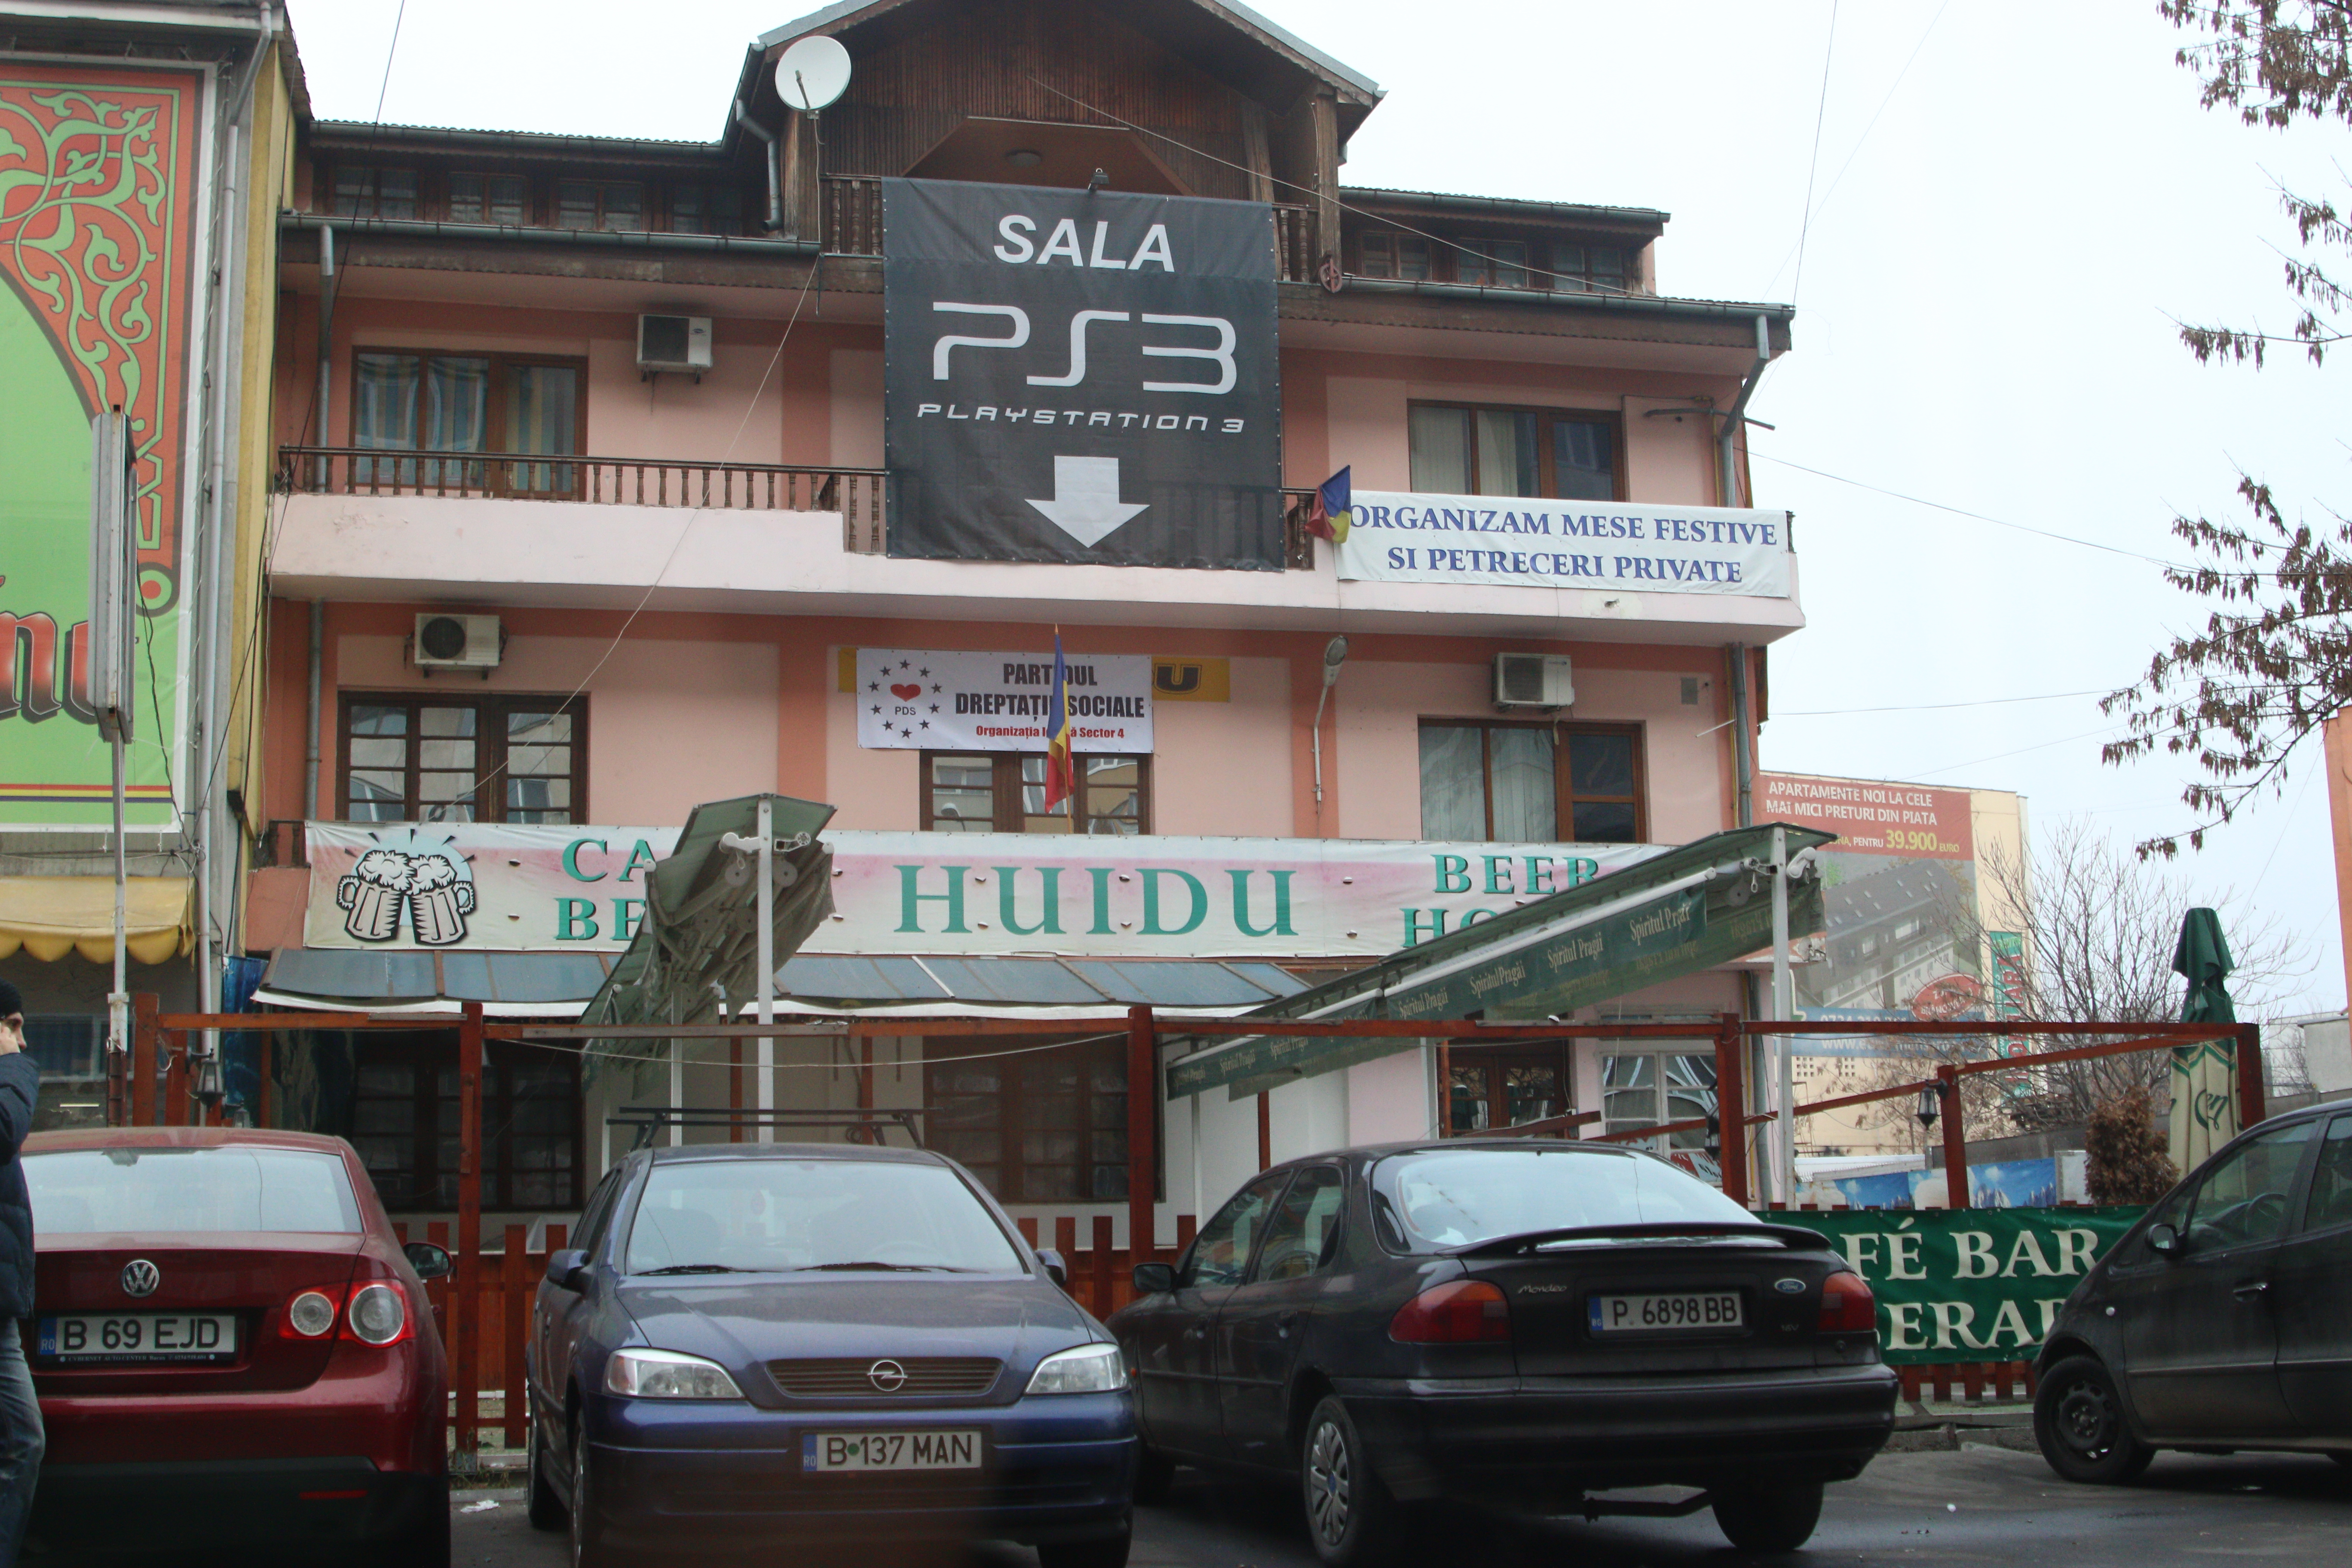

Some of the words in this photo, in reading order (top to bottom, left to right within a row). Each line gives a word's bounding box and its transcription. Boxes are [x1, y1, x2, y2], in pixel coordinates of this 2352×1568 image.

[993, 214, 1175, 273] SALA
[932, 301, 1237, 395] PS3
[917, 404, 1208, 431] PLAYSTATION
[1221, 418, 1244, 433] 3
[1350, 504, 1551, 536] ORGANIZAM
[1561, 513, 1645, 539] MESE
[1654, 518, 1777, 546] FESTIVE
[1388, 547, 1417, 570] SI
[1427, 548, 1604, 577] PETRECERI
[1614, 557, 1742, 583] PRIVATE
[1003, 663, 1098, 686] PARTDUL
[1154, 663, 1202, 695] U
[895, 706, 916, 716] PDS
[1068, 695, 1145, 718] SOCIALE
[976, 725, 1039, 739] Organizația
[1080, 727, 1115, 738] Sector
[1118, 728, 1124, 738] 4
[1769, 781, 1860, 801] APARTAMENTE
[1864, 790, 1886, 803] NOI
[1889, 791, 1904, 805] LA
[1906, 793, 1932, 807] CELE
[1766, 800, 1792, 815] MAI
[1795, 802, 1822, 817] MICI
[1826, 805, 1875, 821] PRETURI
[1878, 808, 1899, 823] DIN
[1903, 811, 1938, 826] PIATA
[1853, 837, 1883, 848] PENTRU
[1886, 829, 1937, 851] 39.900
[1939, 842, 1959, 853] EURO
[562, 839, 655, 882] CA
[1430, 854, 1599, 894] BEER
[893, 864, 1299, 937] HUIDU
[554, 897, 646, 941] BE
[1629, 909, 1665, 946] Spiritul
[1547, 940, 1577, 974] Spiritul
[1470, 968, 1500, 999] Spiritul
[1399, 993, 1425, 1020] Spiritul
[1839, 1217, 1927, 1281] FÉ
[1949, 1228, 2099, 1279] BAR
[1592, 1319, 1602, 1327] BG
[1613, 1300, 1628, 1326] P
[1642, 1298, 1700, 1325] 6898
[1704, 1297, 1737, 1323] BB
[41, 1338, 55, 1351] RO
[64, 1320, 87, 1351] B
[102, 1318, 142, 1350] 69
[155, 1318, 220, 1349] EJD
[804, 1455, 816, 1467] RO
[827, 1437, 848, 1466] B
[860, 1436, 905, 1465] 137
[913, 1434, 972, 1464] MAN
